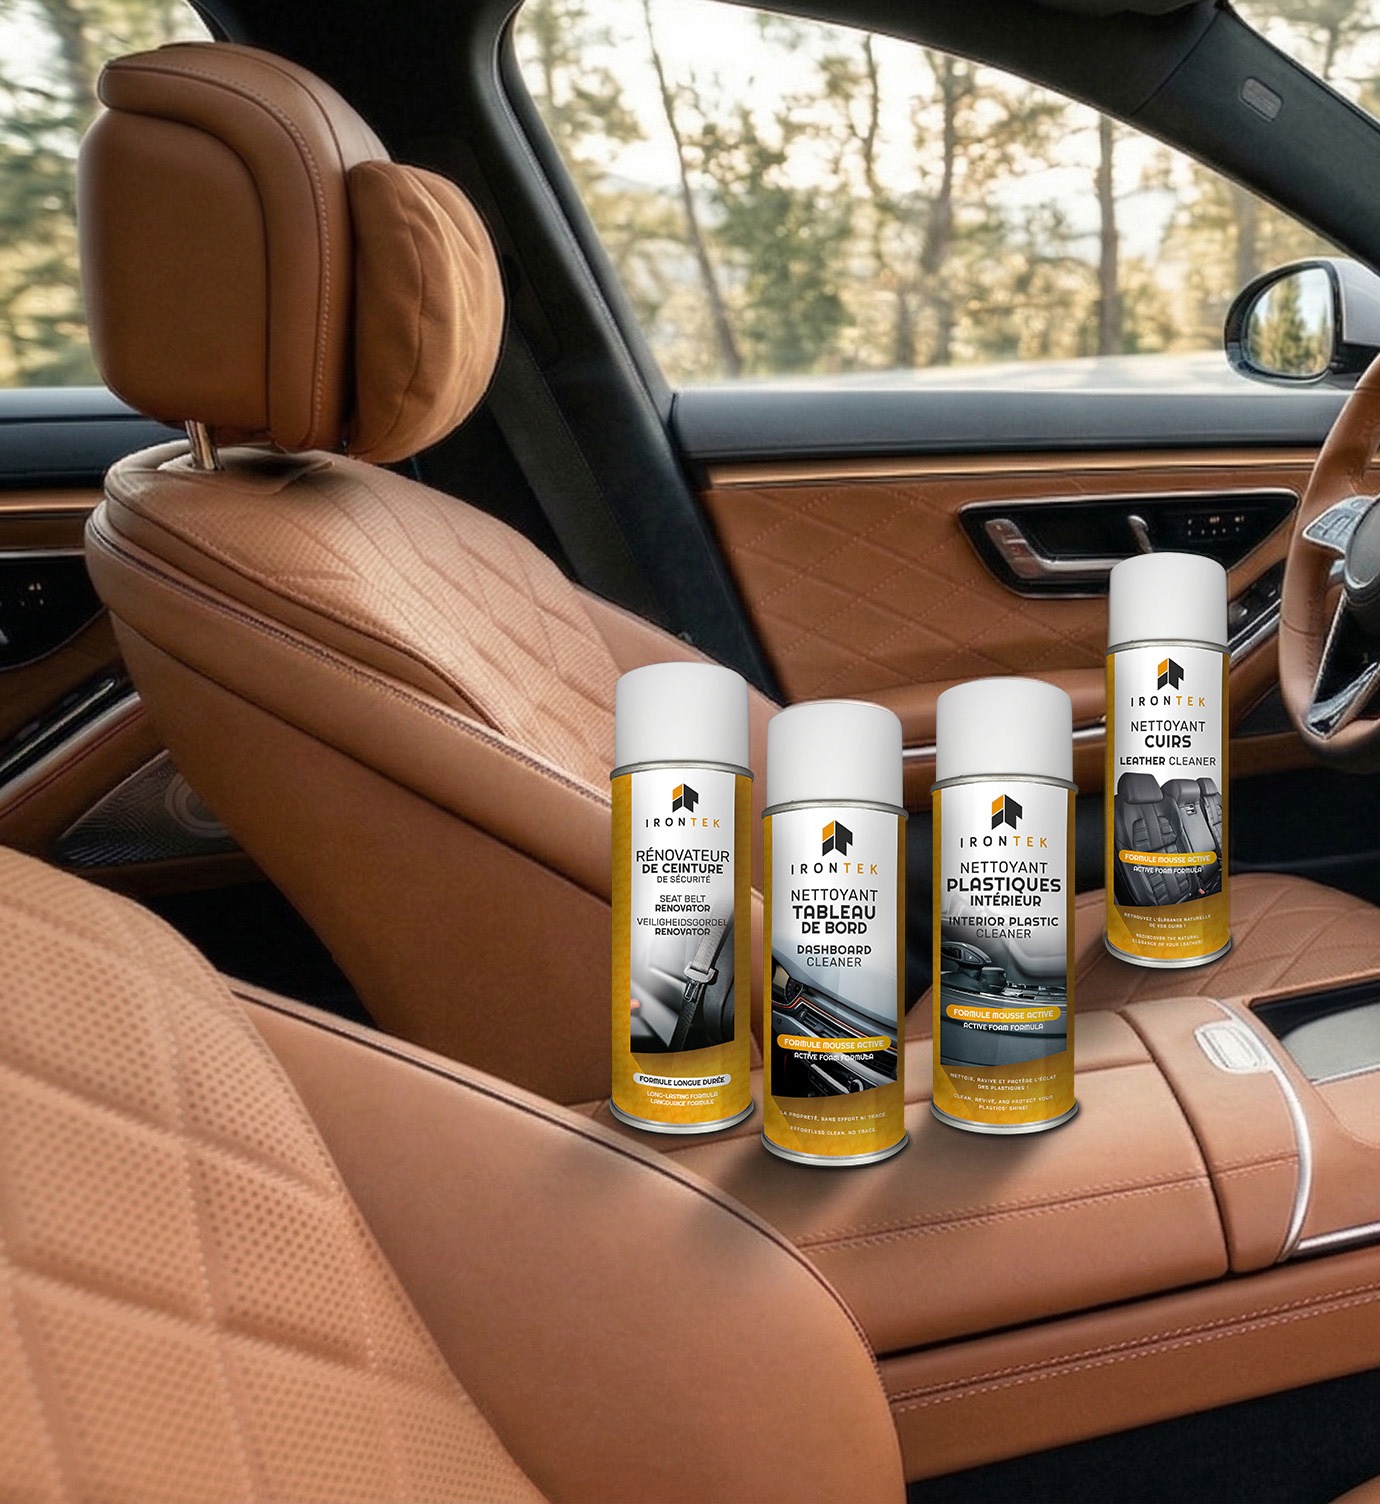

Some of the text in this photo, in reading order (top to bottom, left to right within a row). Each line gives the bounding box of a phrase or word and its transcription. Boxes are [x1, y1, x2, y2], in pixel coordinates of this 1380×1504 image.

[1130, 696, 1206, 707] IRONTEK
[1130, 720, 1206, 732] NETTOYANT
[1145, 735, 1192, 748] CUIRS
[1120, 756, 1216, 766] LEATHER CLEANER
[645, 817, 720, 828] IRONTEK
[960, 835, 1048, 848] IRONTEK
[636, 847, 730, 862] RÉNOVATEUR
[1125, 854, 1211, 864] FORMULE MOUSSE ACTIVE
[642, 863, 724, 874] DE CEINTURE
[791, 862, 878, 875] IRONTEK
[960, 861, 1048, 874] NETTOYANT
[670, 874, 711, 884] SÉCURITÉ
[947, 877, 1061, 894] PLASTIQUES
[791, 888, 878, 902] NETTOYANT
[970, 892, 1042, 906] INTÉRIEUR
[655, 904, 711, 912] RENOVATOR
[792, 905, 876, 920] TABLEAU
[636, 917, 728, 927] VEILIGHEIDSGORDEL
[949, 917, 1059, 926] INTERIOR PLASTIC
[801, 921, 867, 934] DE BORD
[976, 928, 1032, 938] CLEANER
[797, 945, 872, 955] DASHBOARD
[806, 957, 862, 967] CLEANER
[953, 1008, 1054, 1019] FORMULE MOUSSE ACTIVE
[963, 1022, 987, 1030] ACTIVE
[1010, 1023, 1044, 1031] FORMULA
[784, 1038, 821, 1048] FORMULE
[857, 1040, 884, 1048] ACTIVE
[794, 1052, 817, 1060] ACTIVE
[639, 1075, 672, 1086] FORMULE
[703, 1076, 725, 1085] DURÉE
